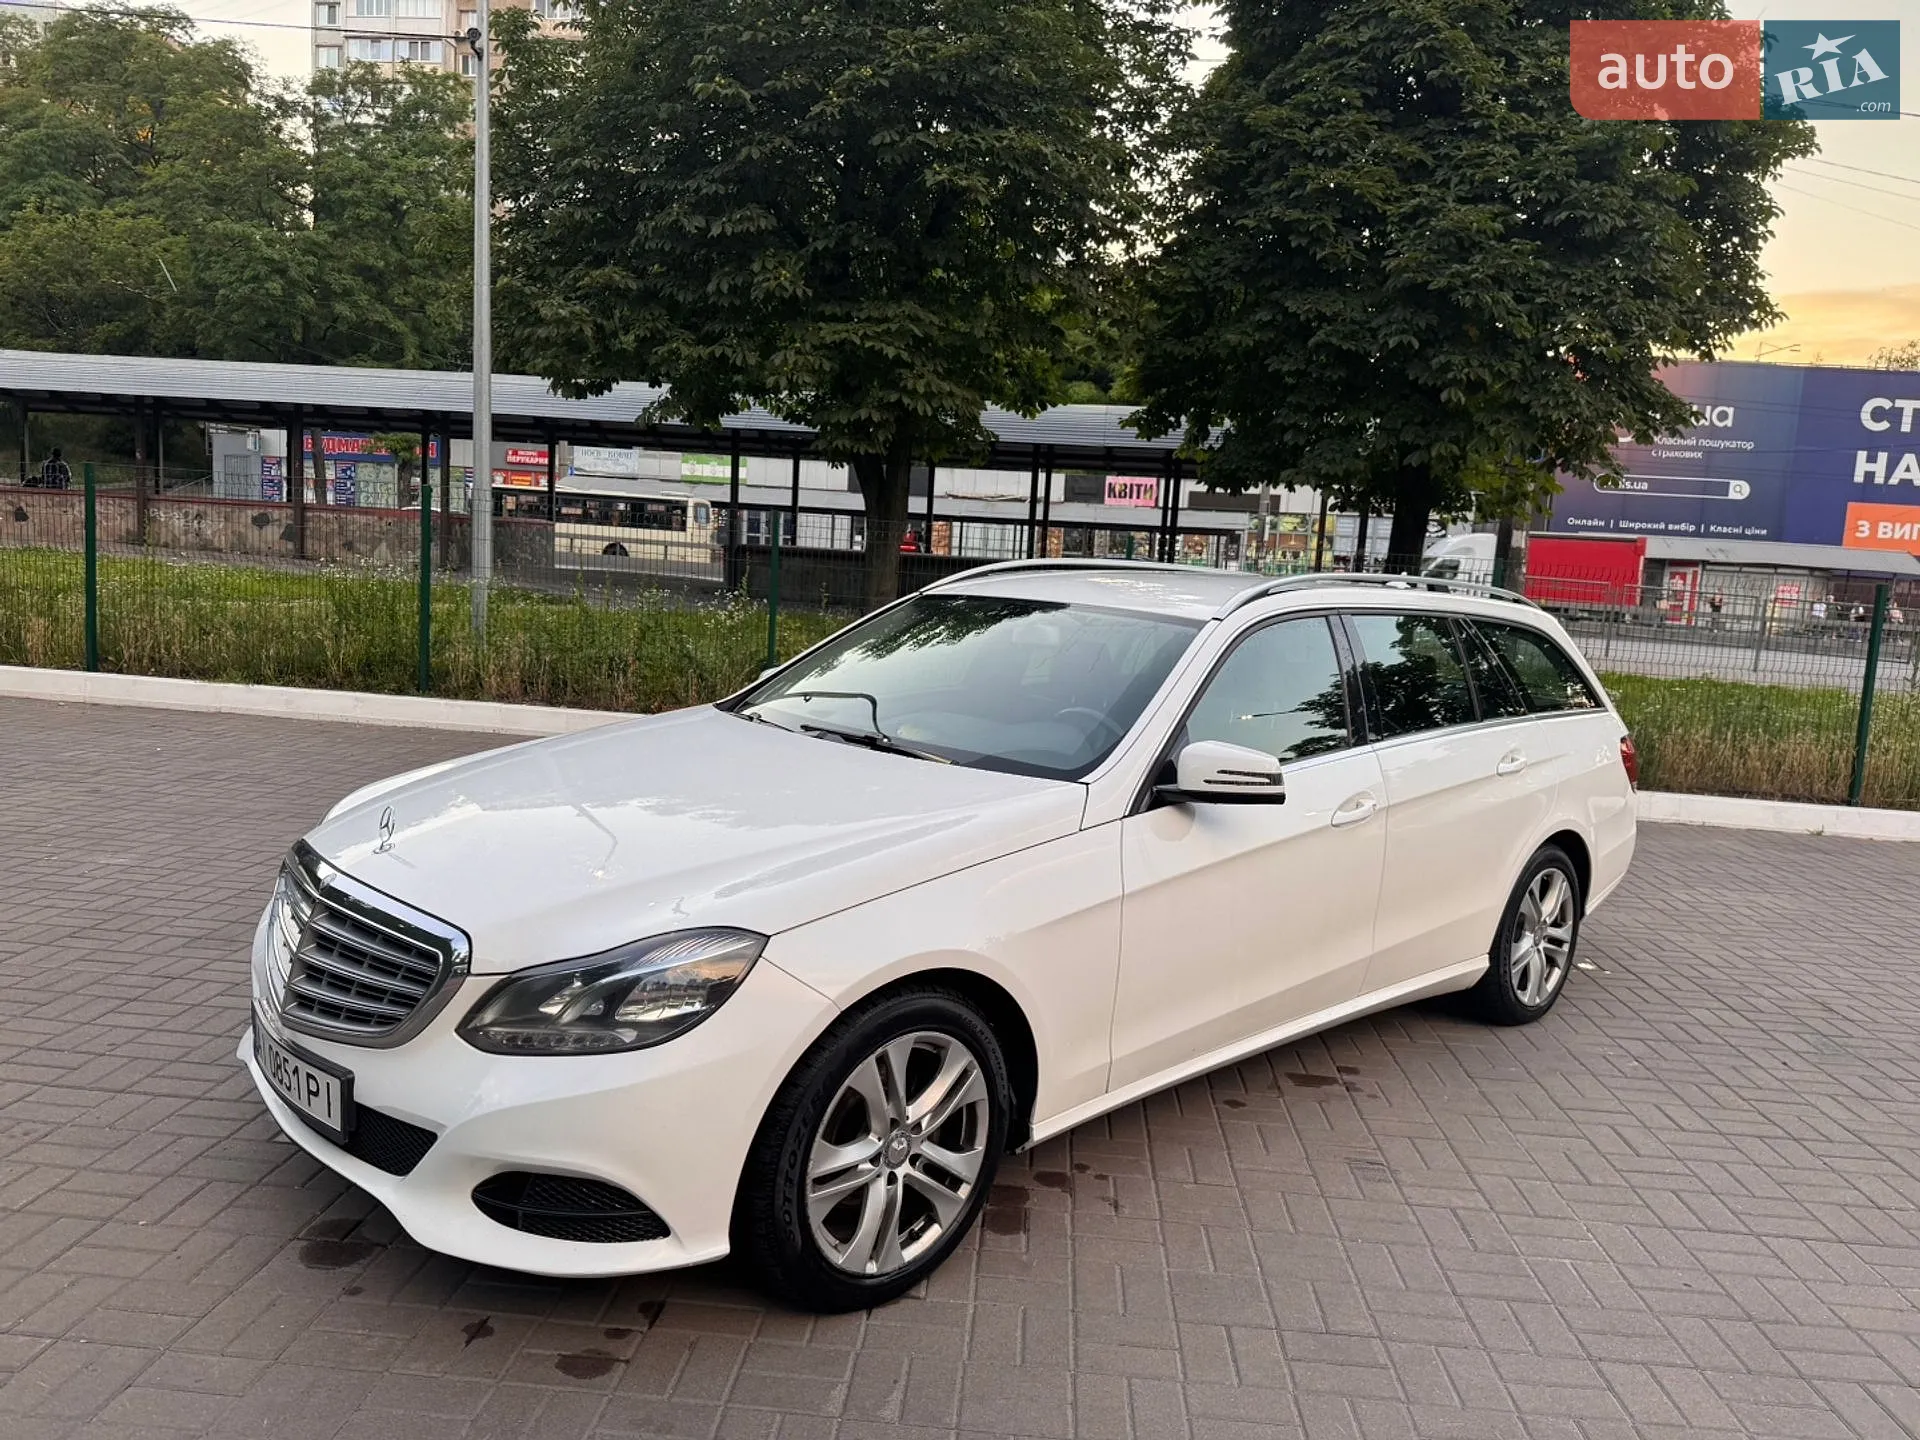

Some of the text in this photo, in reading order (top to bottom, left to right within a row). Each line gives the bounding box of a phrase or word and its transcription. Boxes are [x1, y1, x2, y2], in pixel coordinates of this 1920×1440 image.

[1698, 438, 1755, 450] пошукатор
[1651, 448, 1703, 459] страхових
[1853, 450, 1920, 487] НА
[1107, 482, 1154, 500] КВІТИ
[1567, 517, 1768, 536] Онлайн Широкий вибір Класні ціни
